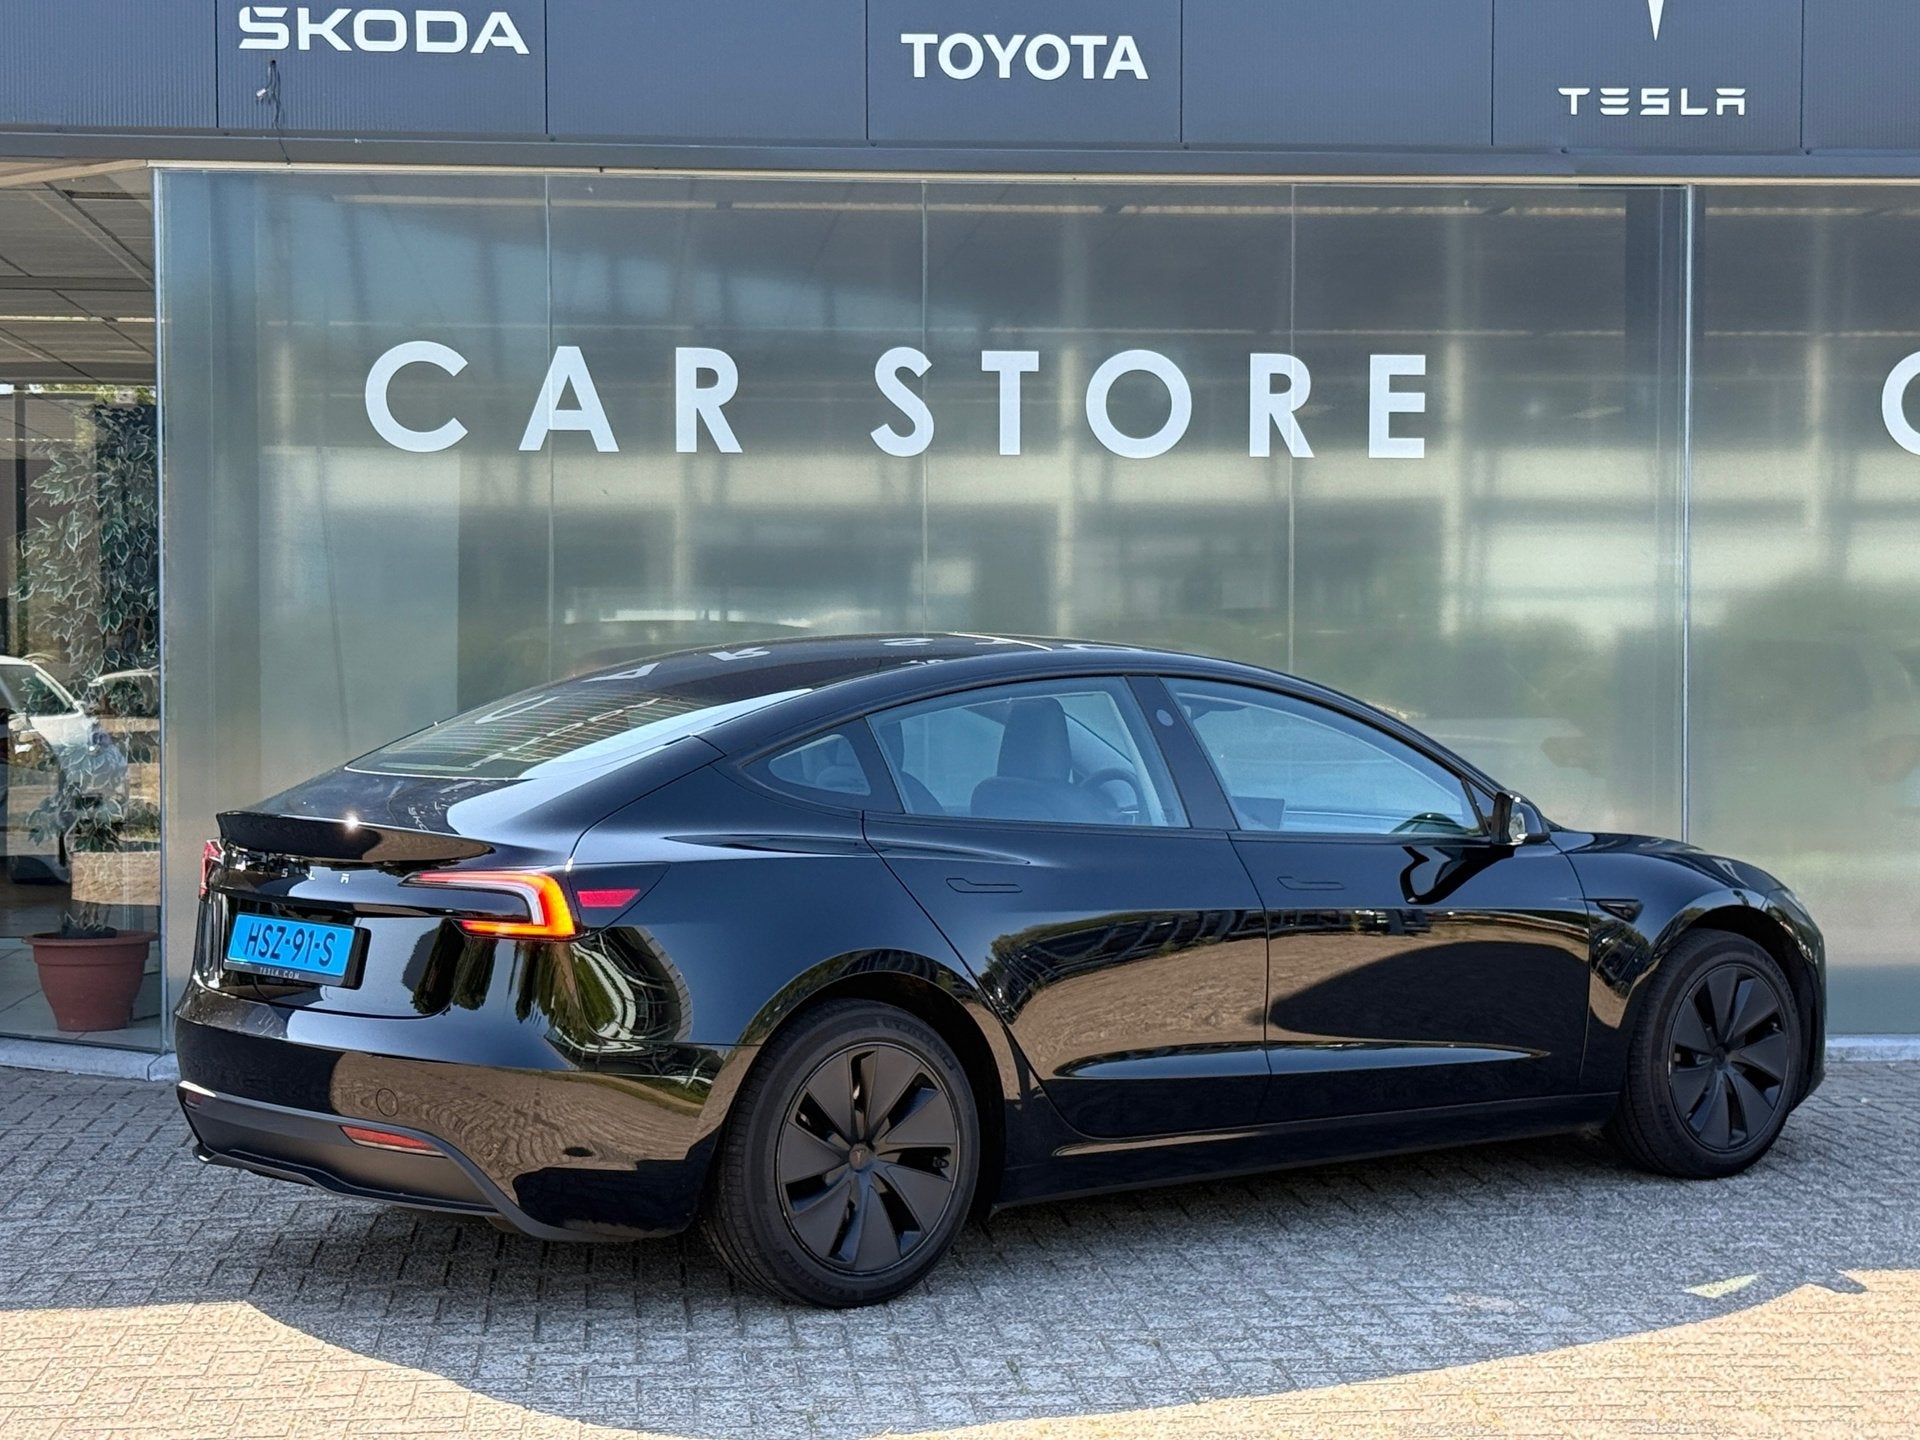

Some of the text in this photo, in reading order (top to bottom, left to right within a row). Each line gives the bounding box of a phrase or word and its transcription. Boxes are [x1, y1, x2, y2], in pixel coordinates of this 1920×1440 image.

[900, 32, 1149, 81] TOYOTA
[1558, 87, 1746, 116] TESLA
[365, 341, 1427, 459] CAR STORE
[245, 922, 336, 967] HSZ-91-S
